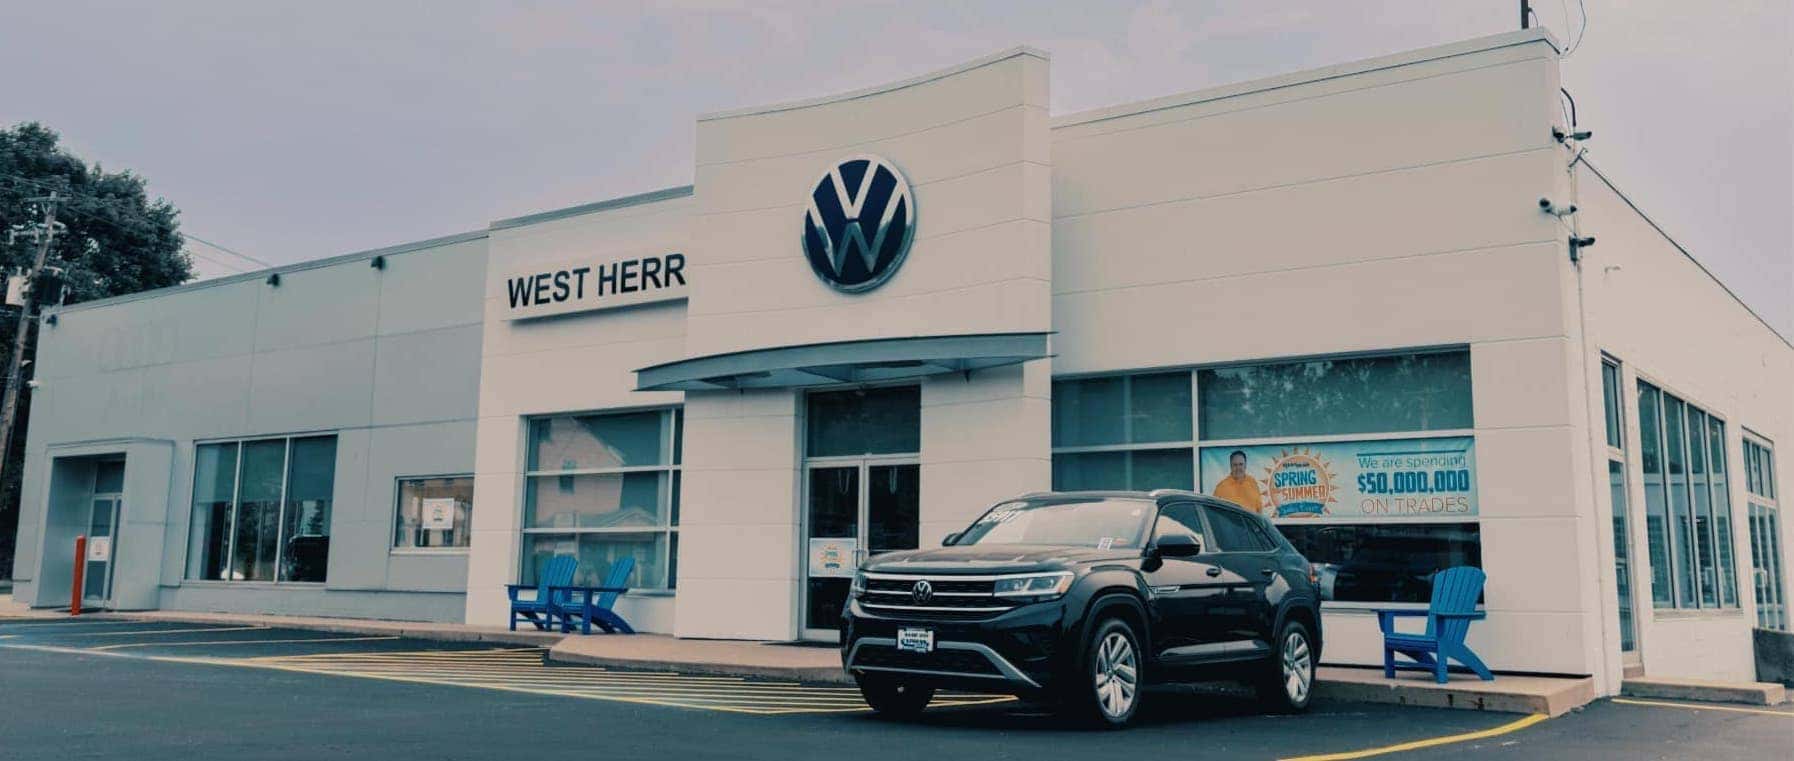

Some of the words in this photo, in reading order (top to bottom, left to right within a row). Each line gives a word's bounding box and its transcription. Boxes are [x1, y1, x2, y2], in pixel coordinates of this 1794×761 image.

[508, 267, 590, 308] WEST
[598, 253, 686, 297] HERR
[1358, 456, 1377, 468] We
[1382, 459, 1401, 468] are
[1406, 455, 1466, 470] spending
[1274, 469, 1317, 488] SPRING
[1357, 469, 1470, 495] $50,000,000
[1281, 484, 1327, 501] SUMMER
[1361, 498, 1389, 514] ON
[1394, 496, 1469, 513] TRADES
